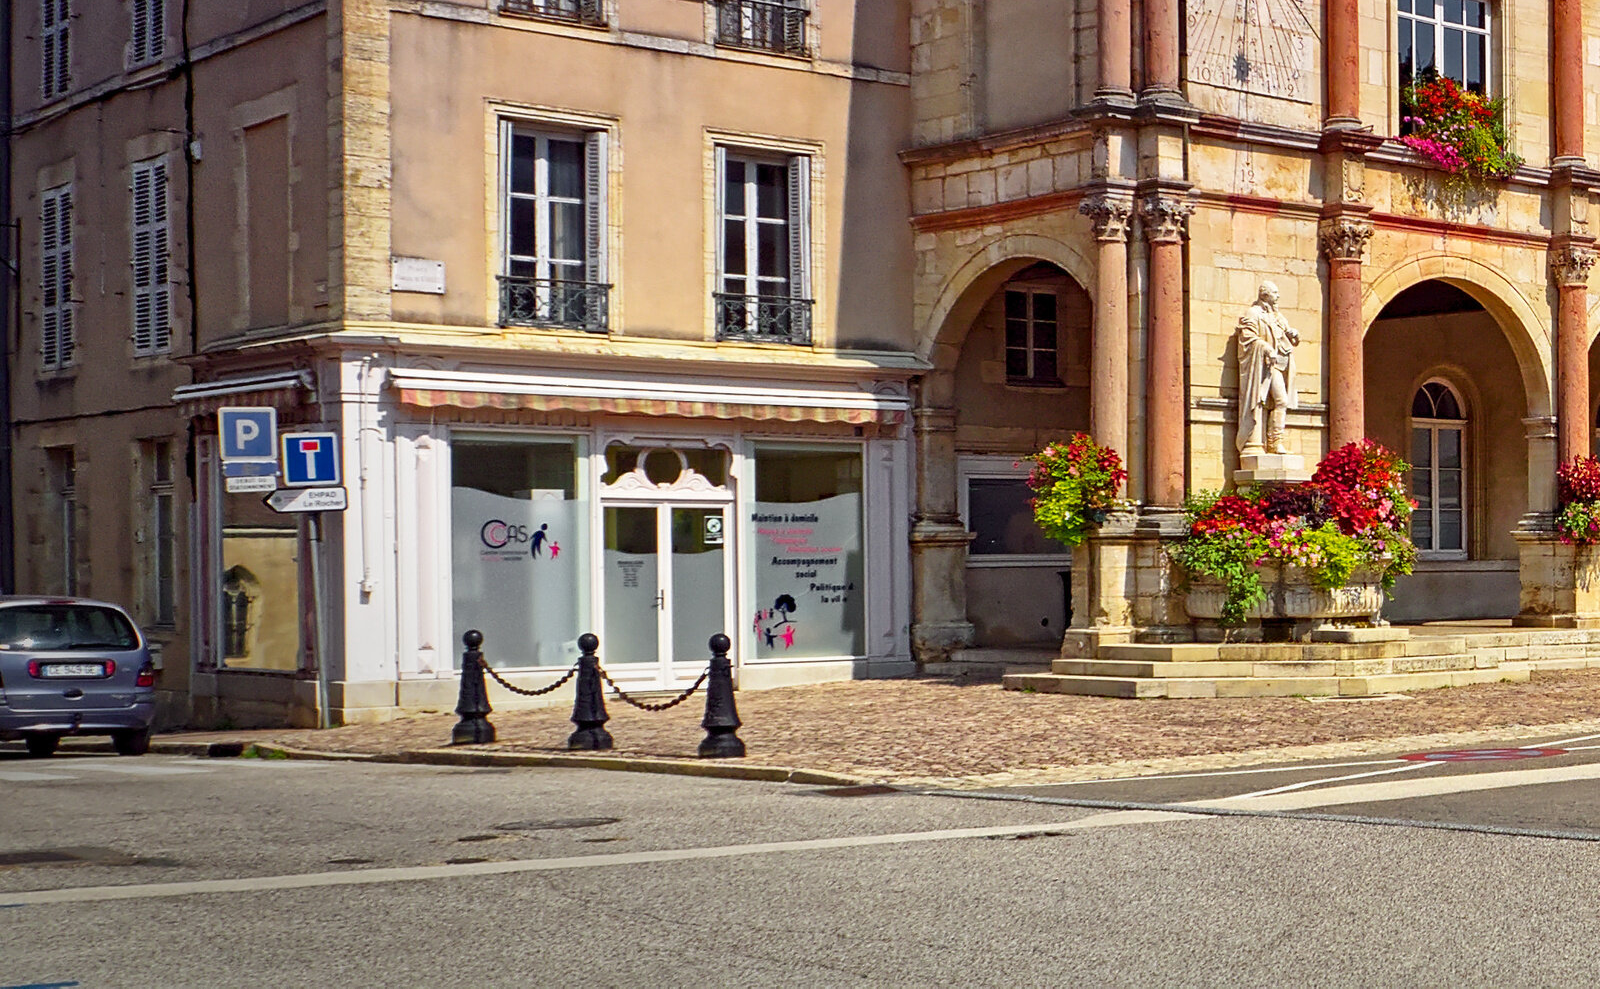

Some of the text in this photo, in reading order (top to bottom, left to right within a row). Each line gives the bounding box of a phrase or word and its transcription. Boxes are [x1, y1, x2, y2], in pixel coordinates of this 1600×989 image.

[1187, 14, 1197, 28] 9
[1196, 67, 1211, 81] 10
[1287, 84, 1294, 98] 2
[1241, 169, 1255, 183] 12
[236, 419, 259, 449] P
[303, 499, 344, 508] Le Rocher
[751, 513, 819, 522] Maintien à domicile
[772, 557, 837, 567] Accompagnement
[795, 570, 817, 579] social
[809, 582, 847, 593] Politique
[821, 595, 848, 603] la vile
